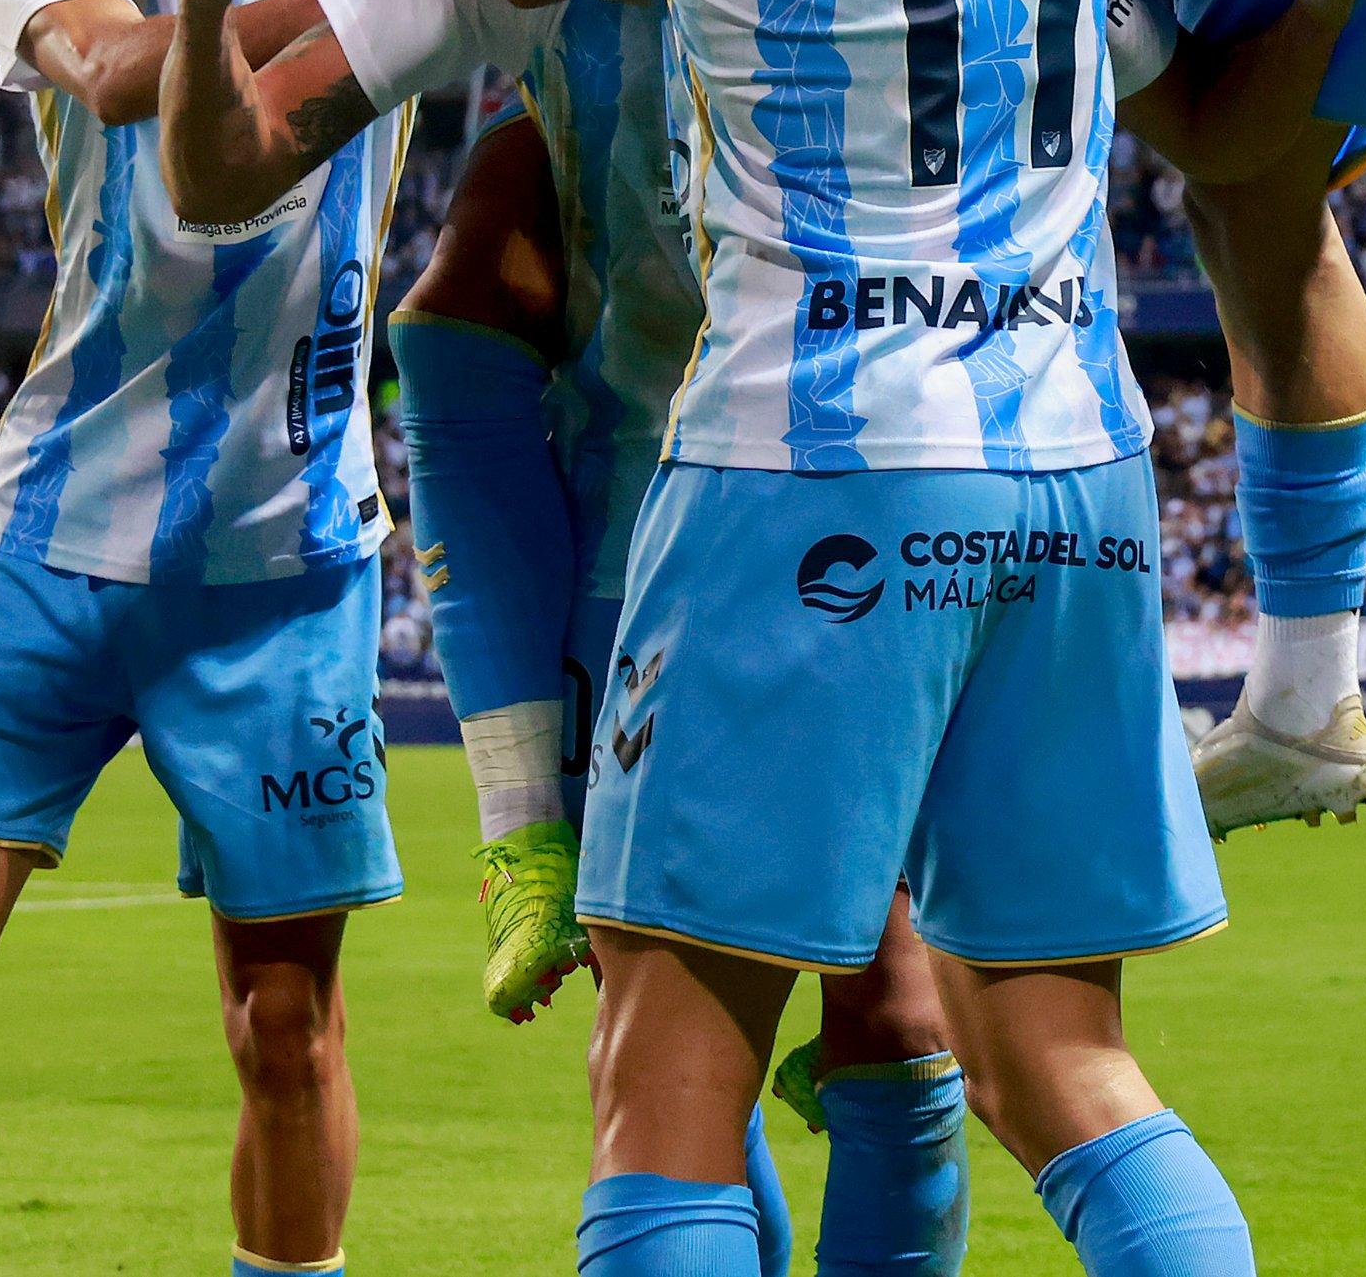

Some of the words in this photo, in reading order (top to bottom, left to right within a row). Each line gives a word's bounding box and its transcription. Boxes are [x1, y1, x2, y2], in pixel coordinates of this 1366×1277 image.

[244, 196, 307, 231] Provincia
[900, 531, 1027, 566] COSTA
[1026, 531, 1086, 567] DEL
[1095, 536, 1151, 574] SOL
[905, 568, 1035, 612] MÁLAGA
[261, 760, 375, 813] MGS
